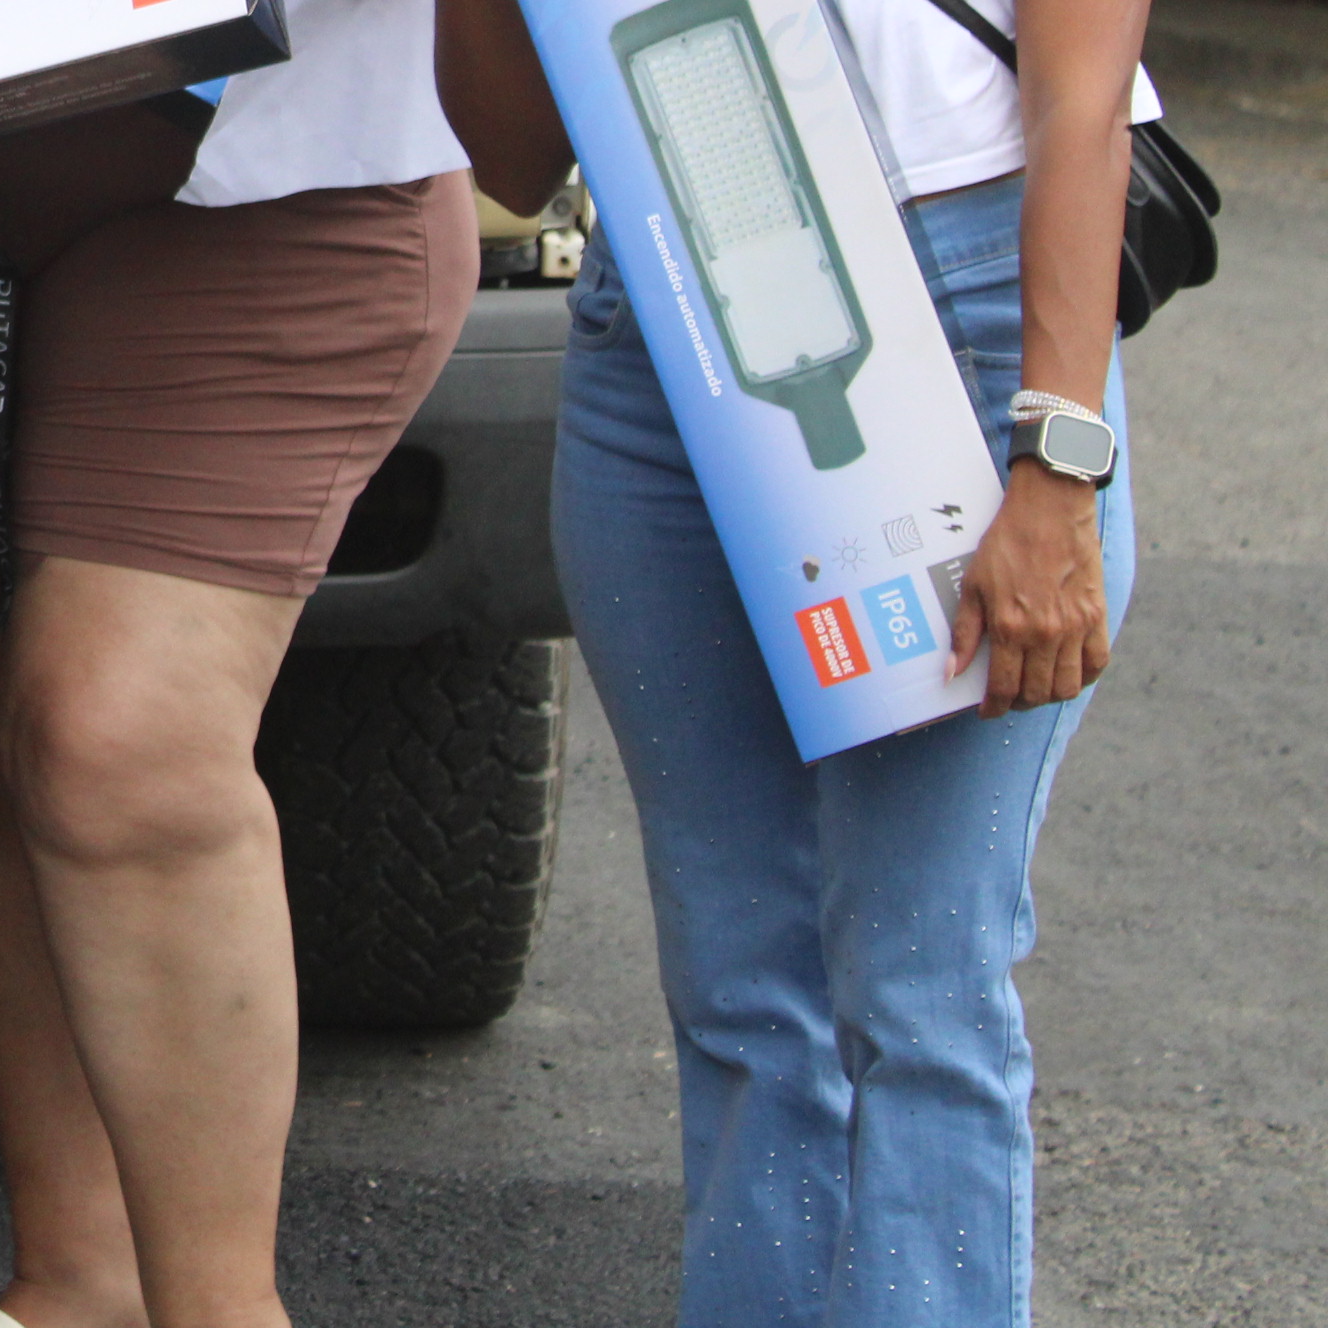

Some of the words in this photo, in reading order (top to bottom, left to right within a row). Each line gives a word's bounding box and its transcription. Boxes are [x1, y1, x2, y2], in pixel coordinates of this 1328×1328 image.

[646, 213, 684, 293] Encendido
[676, 294, 723, 397] automatizado
[809, 611, 826, 635] PICO
[817, 633, 832, 649] DE
[821, 606, 850, 660] SUPRESOR
[841, 658, 855, 675] DE
[877, 588, 919, 649] IP65
[824, 647, 843, 679] 4000V
